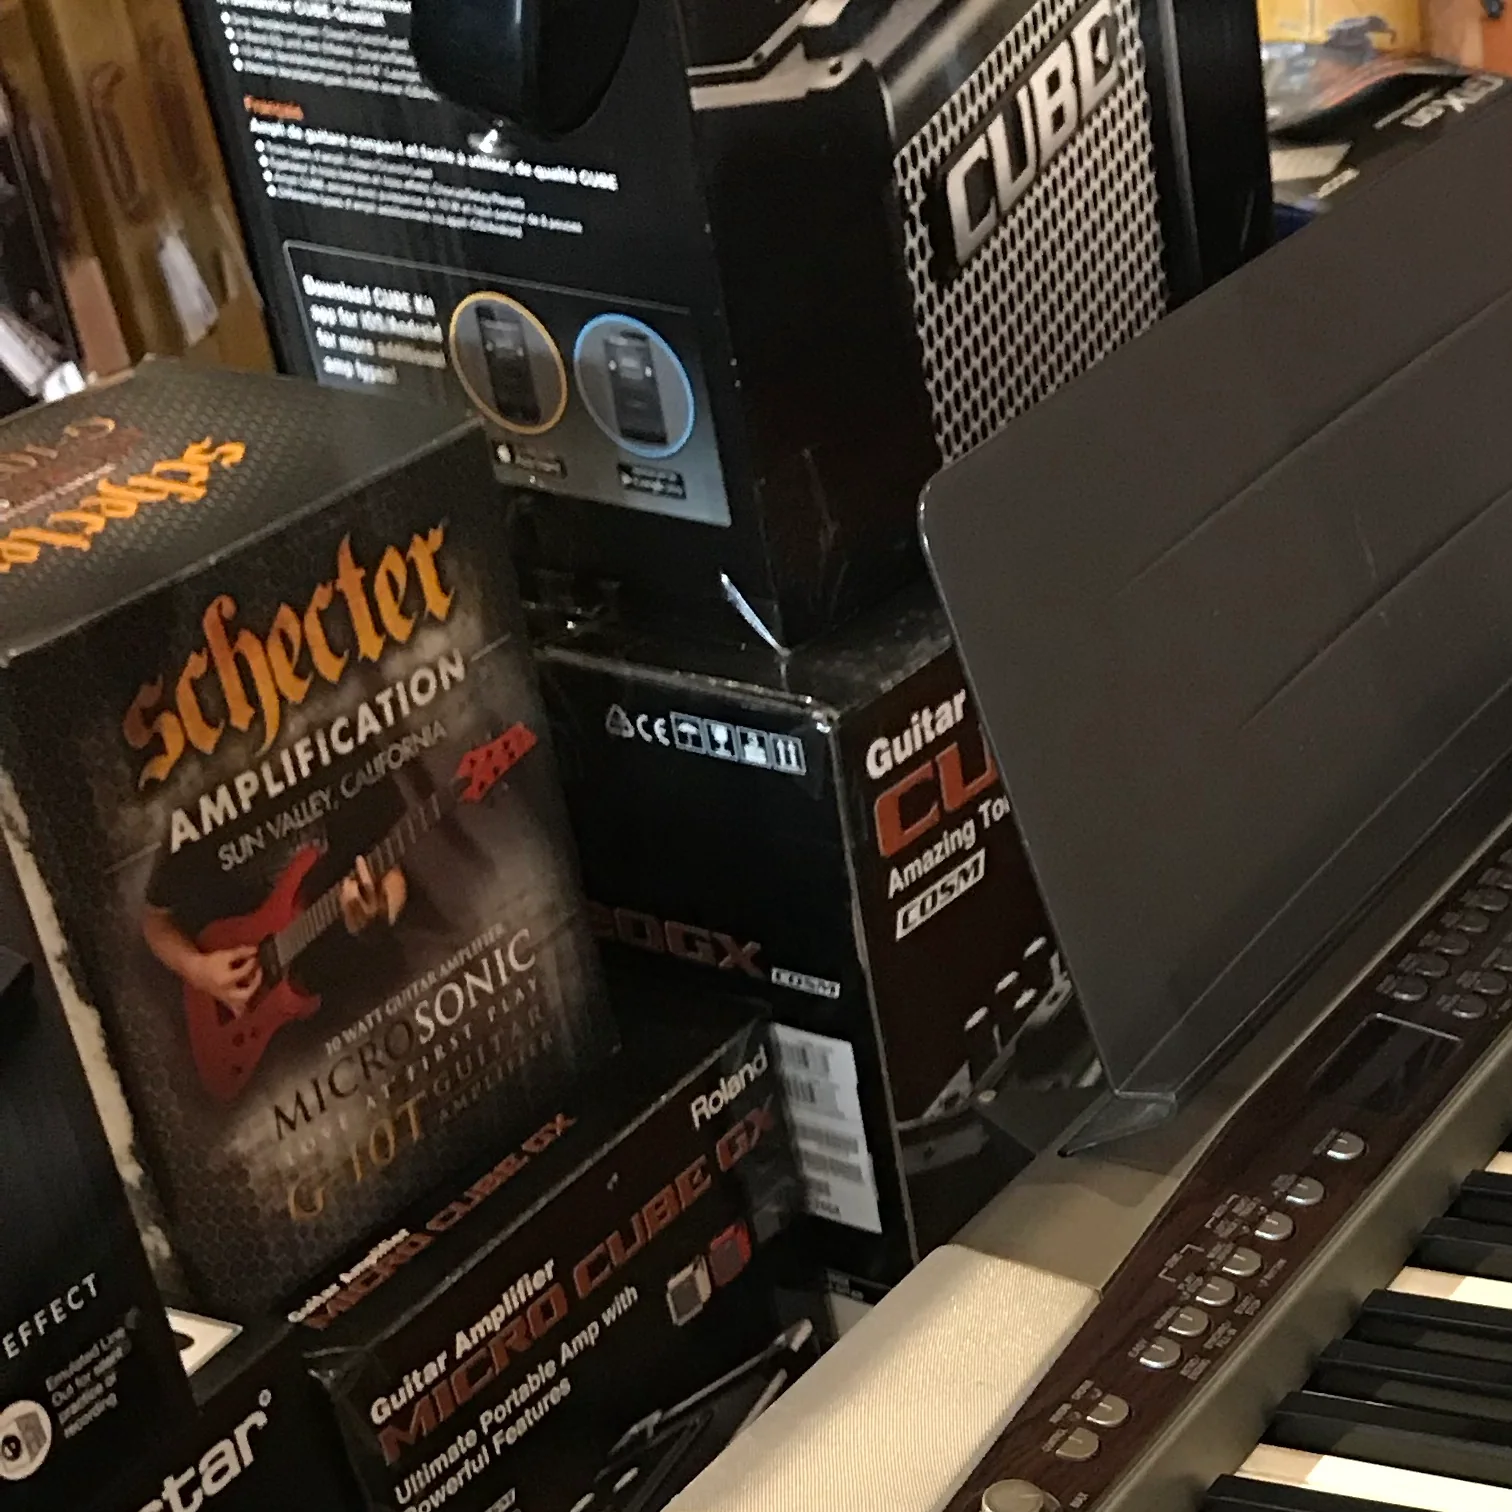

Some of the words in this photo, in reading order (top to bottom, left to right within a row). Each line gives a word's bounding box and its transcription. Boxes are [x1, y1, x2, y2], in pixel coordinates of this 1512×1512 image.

[946, 0, 1121, 268] CUBE
[170, 648, 466, 854] AMPLIFICATION
[866, 688, 966, 780] Guitar
[218, 825, 267, 872] SUN
[266, 787, 339, 840] VALLEY,
[339, 721, 448, 799] CALIFORNIA
[888, 818, 976, 899] Amazing
[899, 850, 985, 935] COSM
[325, 1037, 341, 1056] 10
[341, 1007, 382, 1044] WATT
[386, 971, 437, 1016] GUITAR
[488, 975, 538, 1022] PLAY
[433, 1003, 545, 1095] GUITAR
[691, 1044, 768, 1131] Roland
[2, 1272, 97, 1359] EFFECT
[371, 1350, 448, 1425] Guitar
[455, 1258, 555, 1359] Amplifier
[378, 1282, 568, 1467] MICRO
[573, 1154, 712, 1299] CUBE
[395, 1429, 477, 1504] Ultimate
[480, 1359, 556, 1434] Portable
[560, 1320, 600, 1366] Amp
[601, 1285, 639, 1328] with
[492, 1377, 571, 1454] Features
